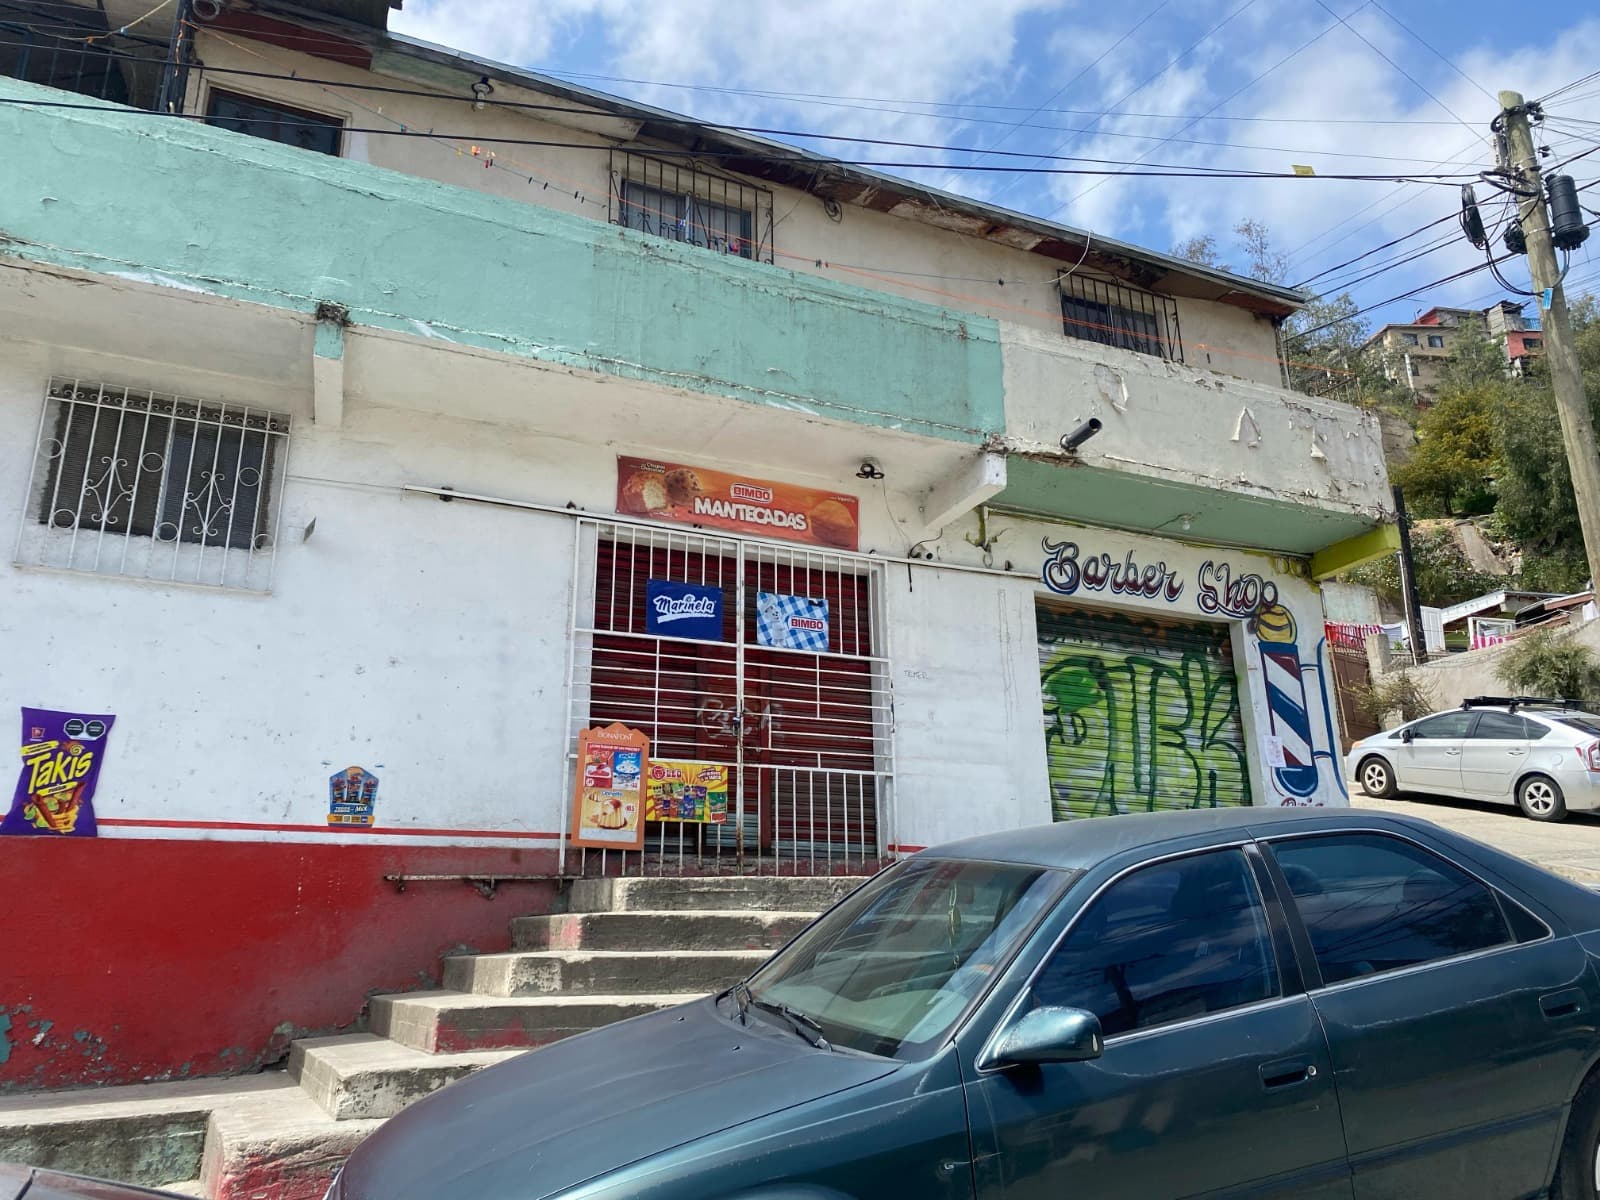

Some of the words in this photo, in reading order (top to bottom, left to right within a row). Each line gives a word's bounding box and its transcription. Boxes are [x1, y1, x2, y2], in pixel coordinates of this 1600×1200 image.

[732, 485, 771, 501] BIMBO
[693, 496, 808, 531] MANTECADAS
[1041, 535, 1185, 602] Barber
[652, 594, 715, 615] Marinela
[790, 618, 825, 631] BIMBO
